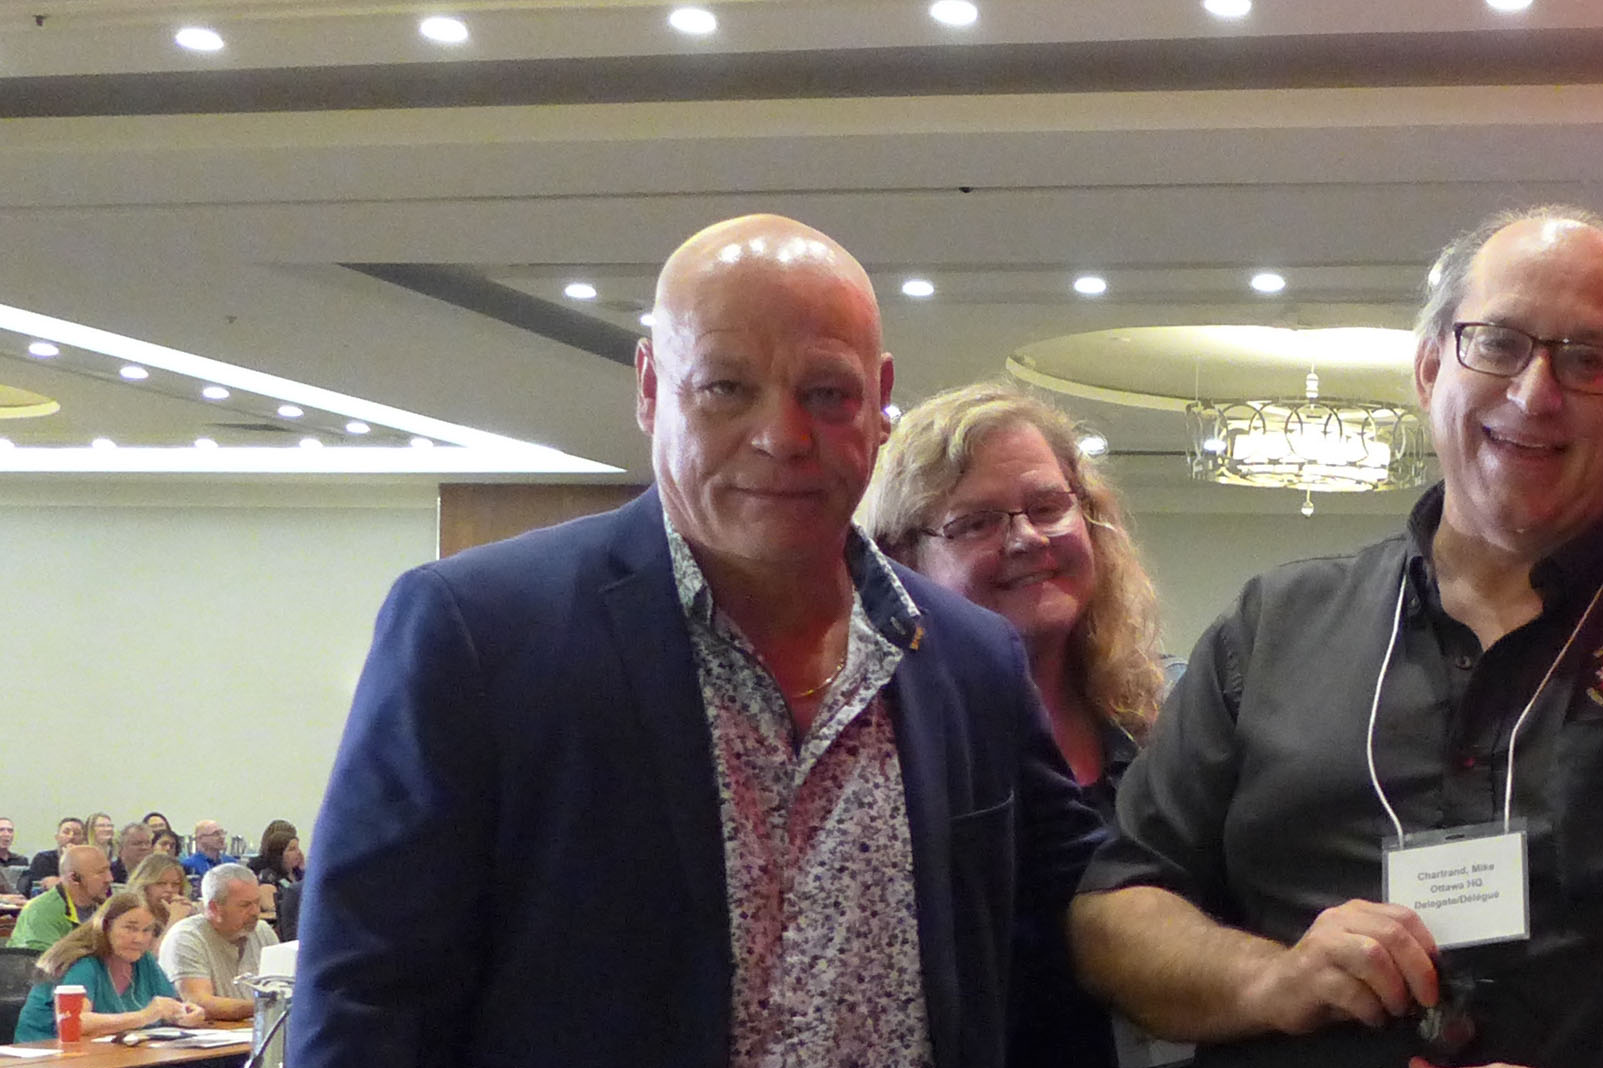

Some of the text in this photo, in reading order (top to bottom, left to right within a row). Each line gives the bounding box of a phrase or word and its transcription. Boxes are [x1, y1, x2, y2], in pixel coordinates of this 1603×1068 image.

[1417, 863, 1495, 881] Chartrand, Mike
[1430, 878, 1483, 893] Ottawa HQ
